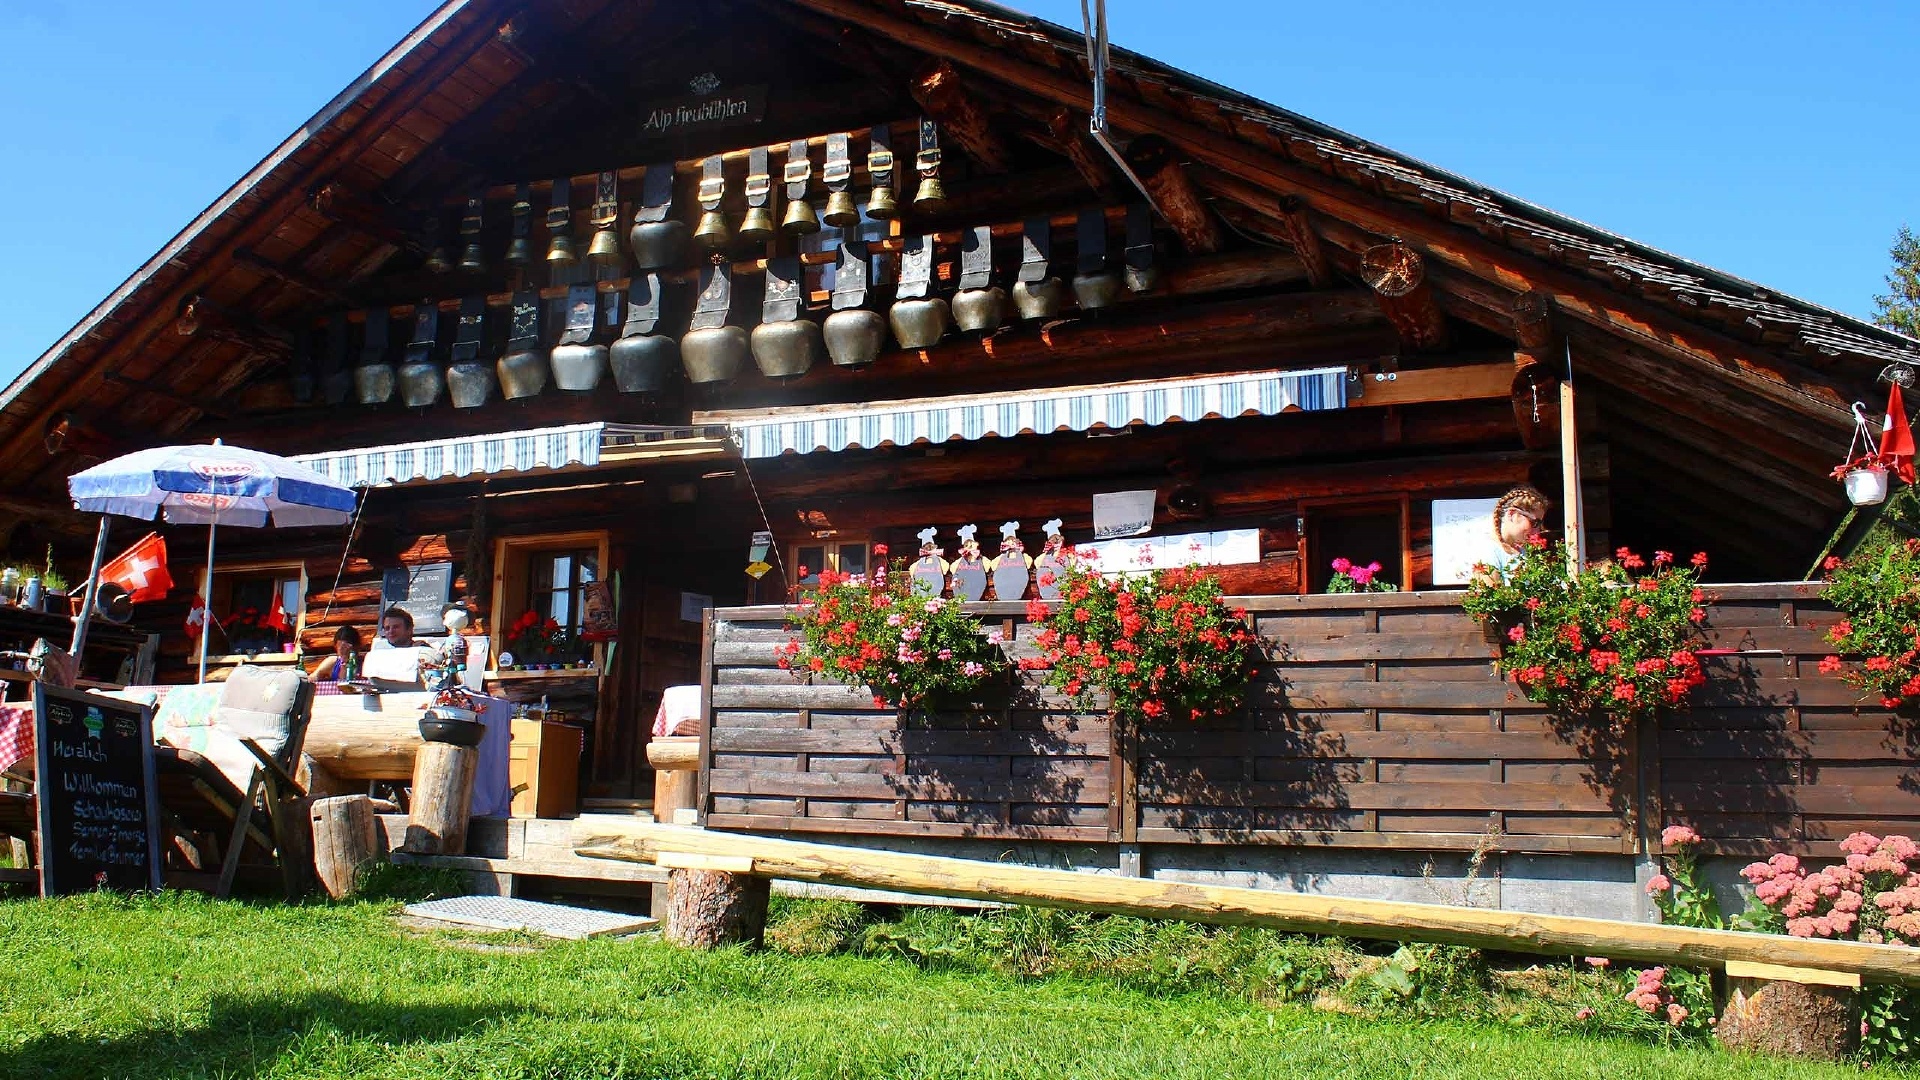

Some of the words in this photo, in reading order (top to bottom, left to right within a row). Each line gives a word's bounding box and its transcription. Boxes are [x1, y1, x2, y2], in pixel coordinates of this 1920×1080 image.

[642, 109, 672, 132] Alp
[202, 464, 252, 474] Frisco
[53, 740, 108, 763] Herzlich
[64, 771, 137, 799] Willkommen
